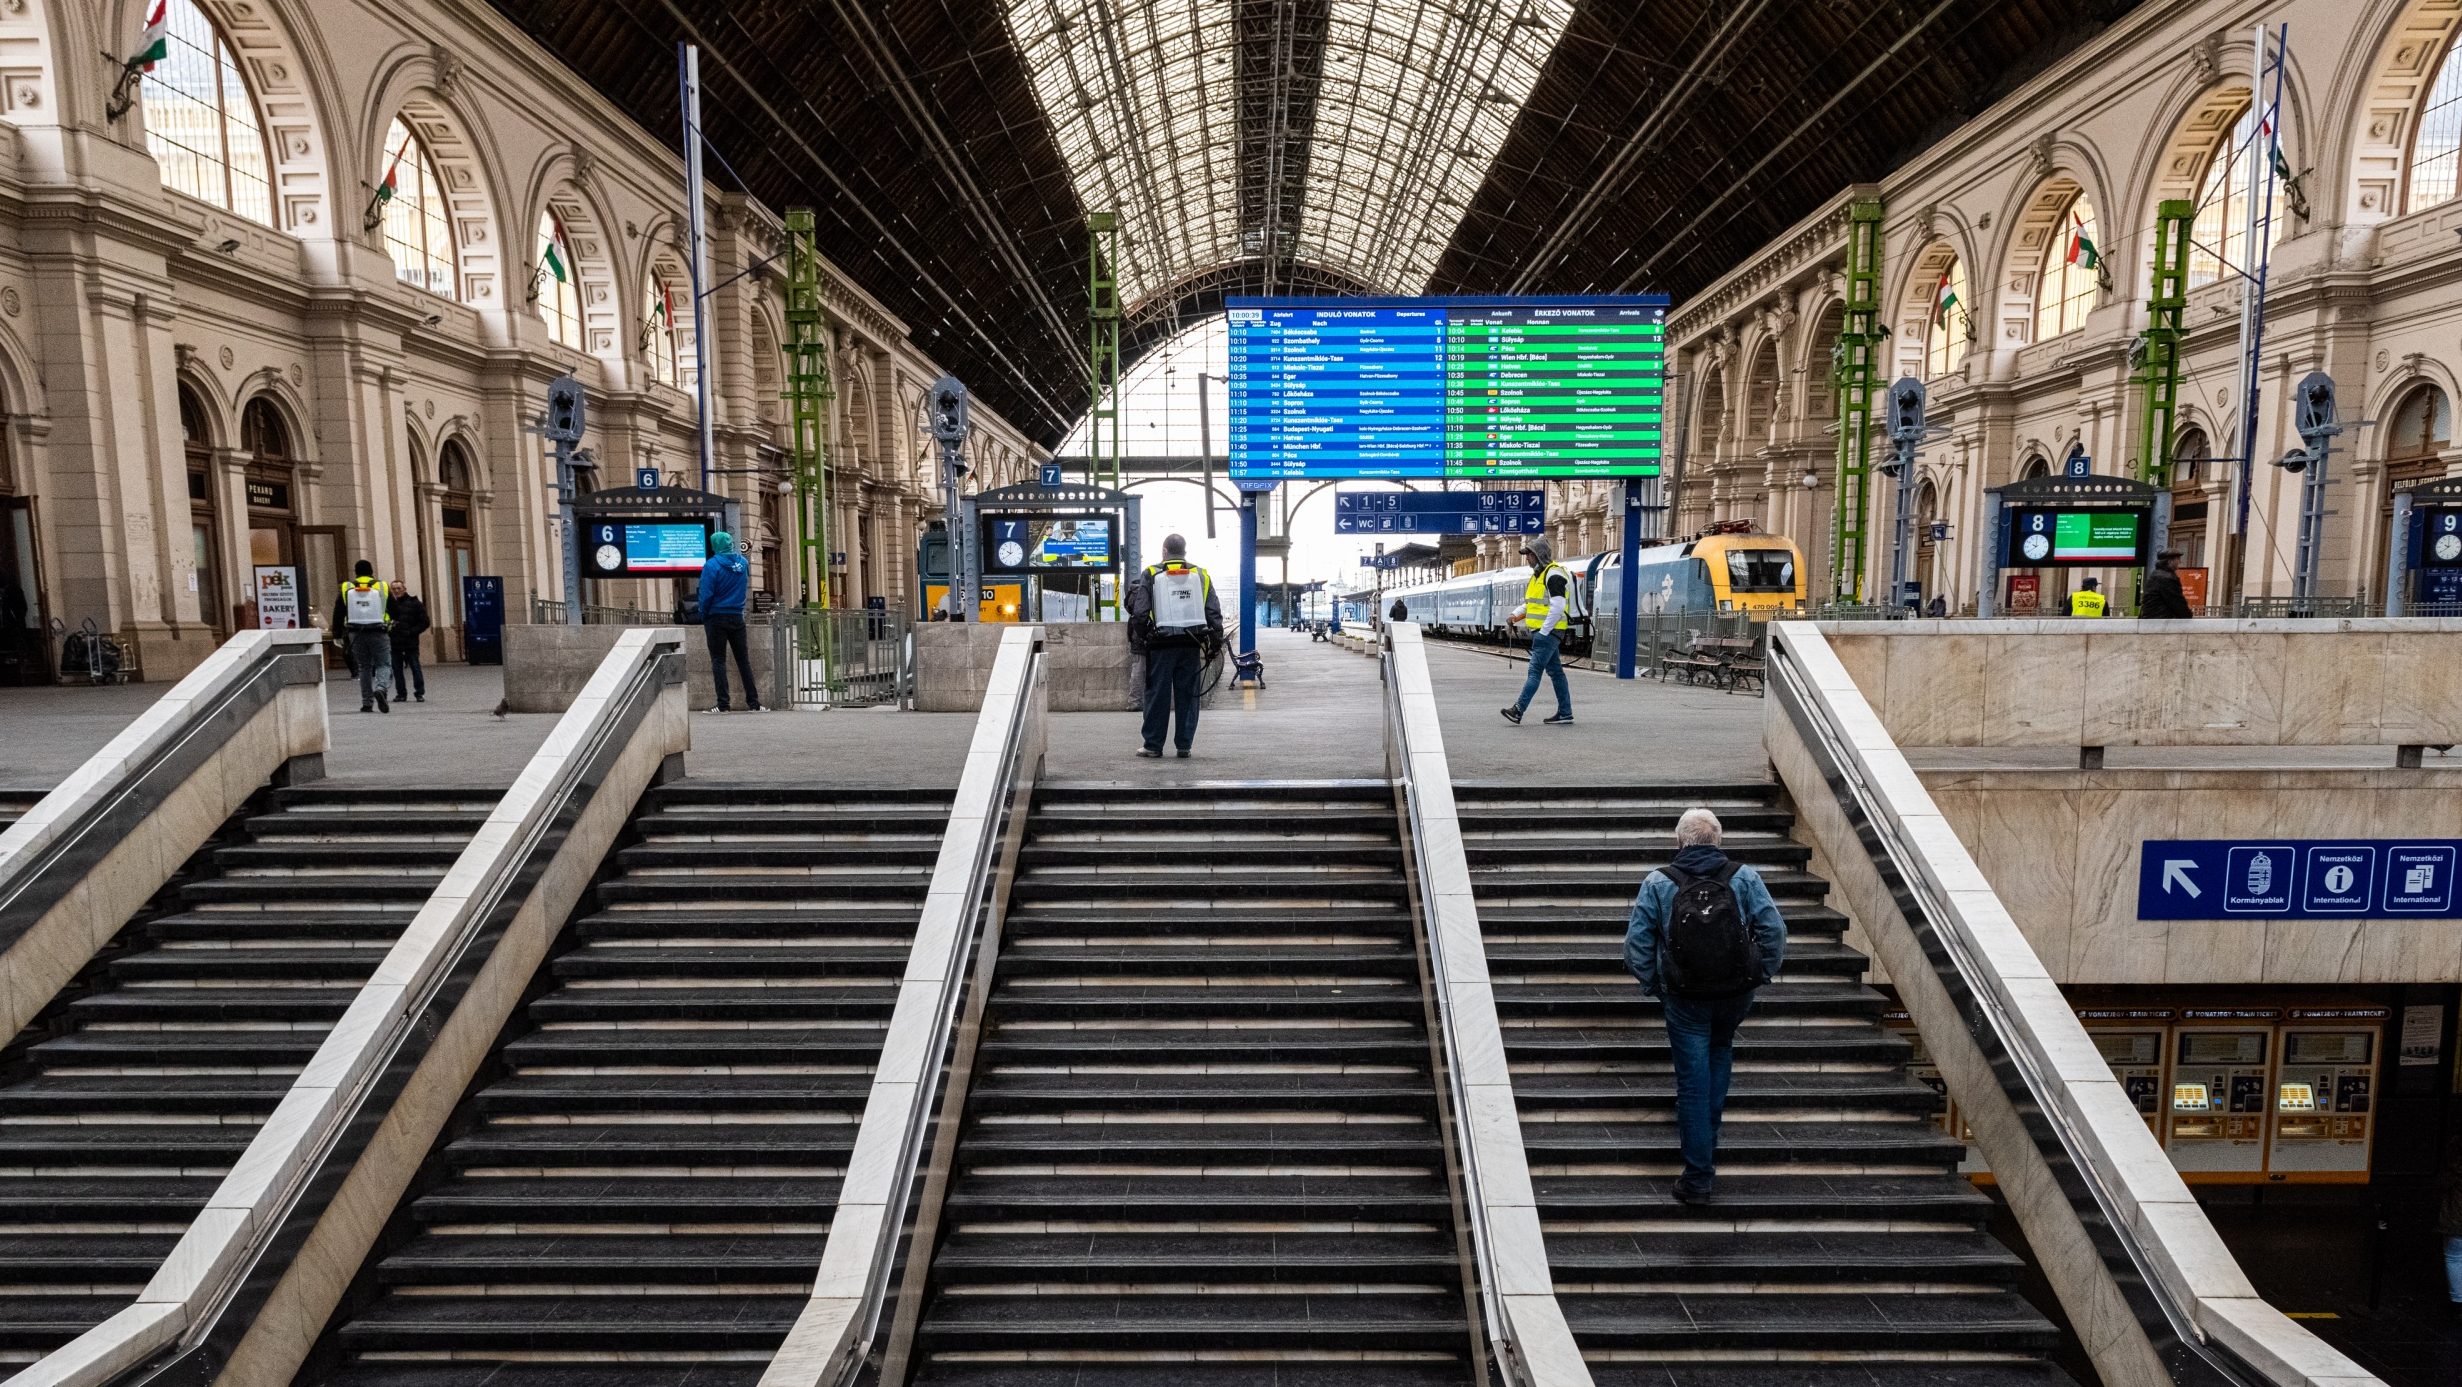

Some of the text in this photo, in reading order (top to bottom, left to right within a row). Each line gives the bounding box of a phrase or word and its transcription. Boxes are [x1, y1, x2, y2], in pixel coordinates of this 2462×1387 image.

[2074, 462, 2084, 474] 8
[643, 474, 653, 486] 6
[1046, 470, 1055, 482] 7
[1363, 496, 1396, 506] 1 5
[1481, 495, 1519, 505] 10 13
[2032, 515, 2044, 531] 8
[2444, 515, 2456, 531] 9
[602, 526, 614, 542] 6
[1005, 522, 1016, 538] 7
[982, 591, 993, 599] 10
[2078, 601, 2100, 609] 3386
